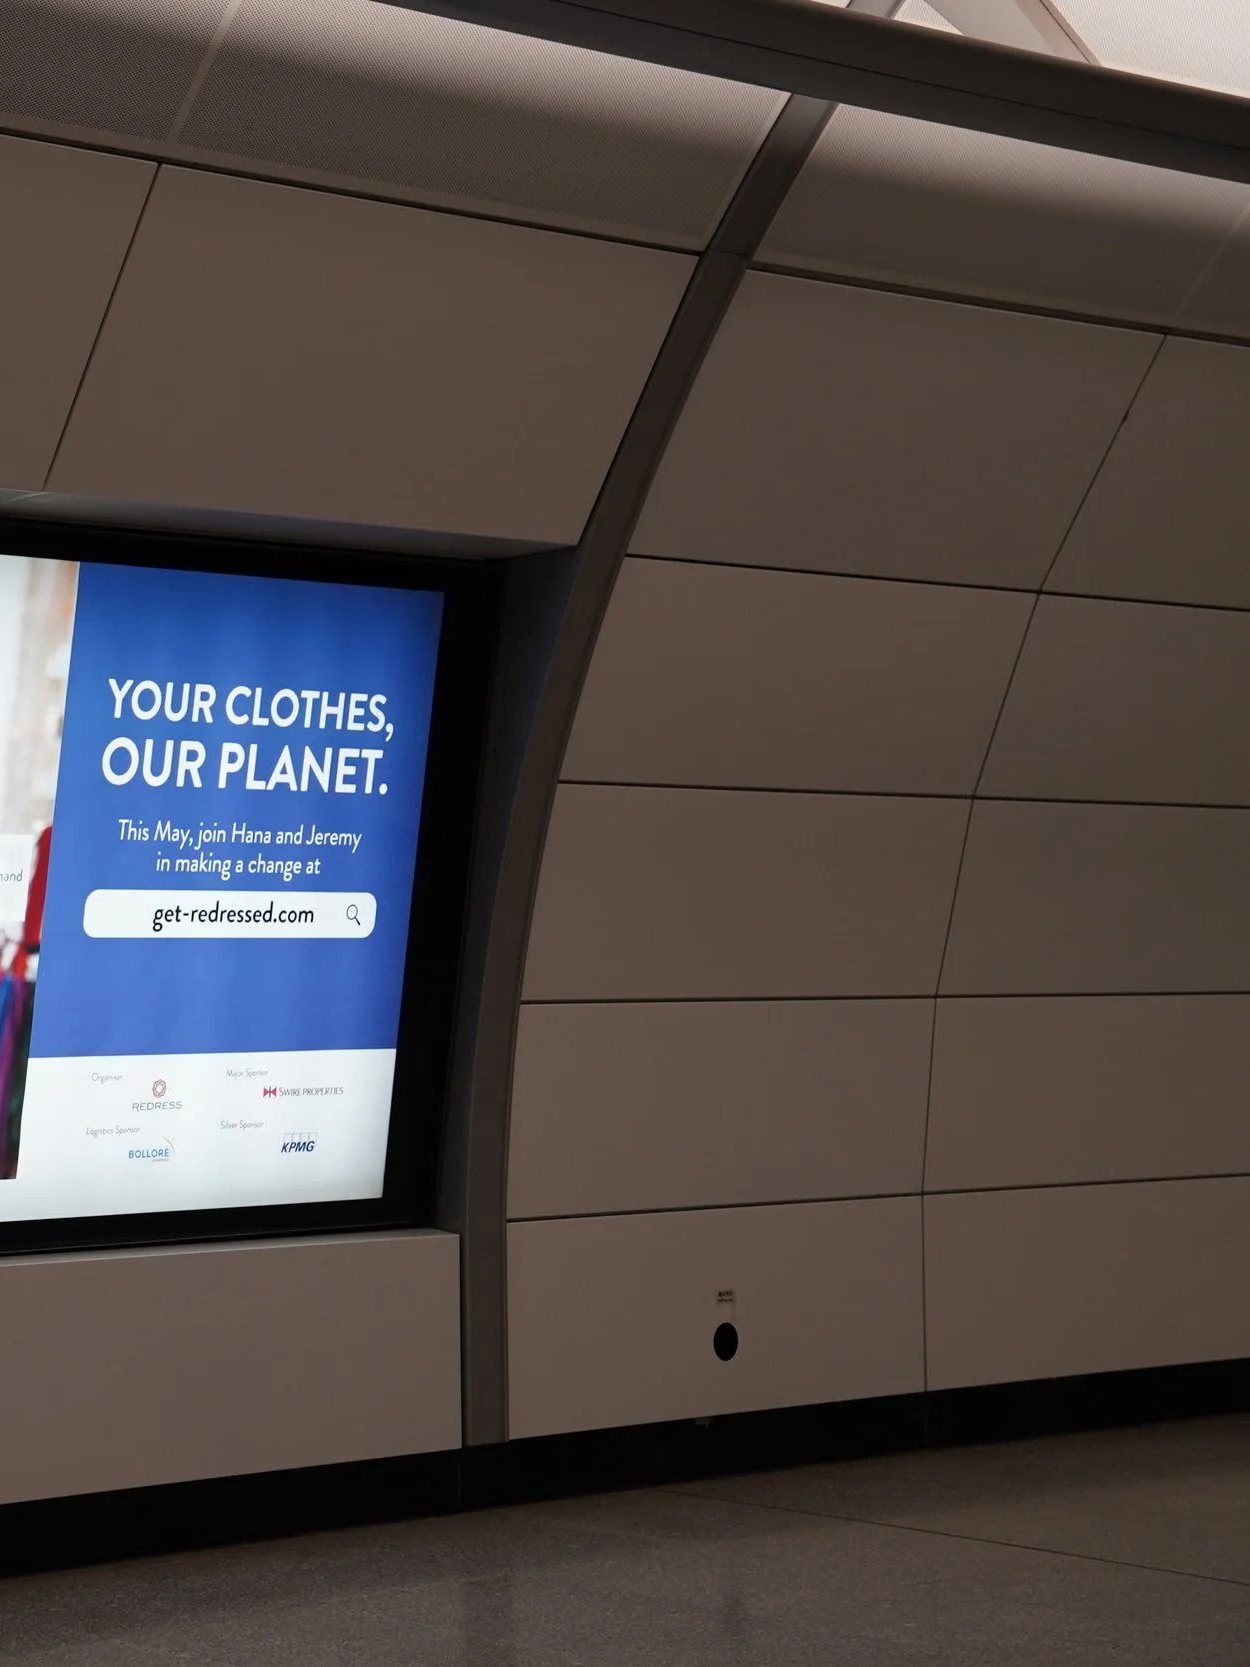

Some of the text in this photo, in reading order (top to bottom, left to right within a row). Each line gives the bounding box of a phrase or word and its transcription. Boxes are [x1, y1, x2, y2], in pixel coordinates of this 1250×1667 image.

[108, 678, 394, 742] YOUR CLOTHES,
[102, 736, 388, 795] OUR PLANET.
[118, 819, 362, 853] This May, join Hana and Jeremy
[156, 852, 321, 882] in making a change at
[152, 900, 314, 932] get-redressed.com
[226, 1068, 269, 1080] Major Sponsor
[302, 1086, 344, 1097] PROPERTIES
[131, 1101, 182, 1112] REDRESS
[115, 1125, 141, 1136] Sponsor
[220, 1119, 264, 1131] Silver Sponsor
[281, 1140, 315, 1153] KPMG
